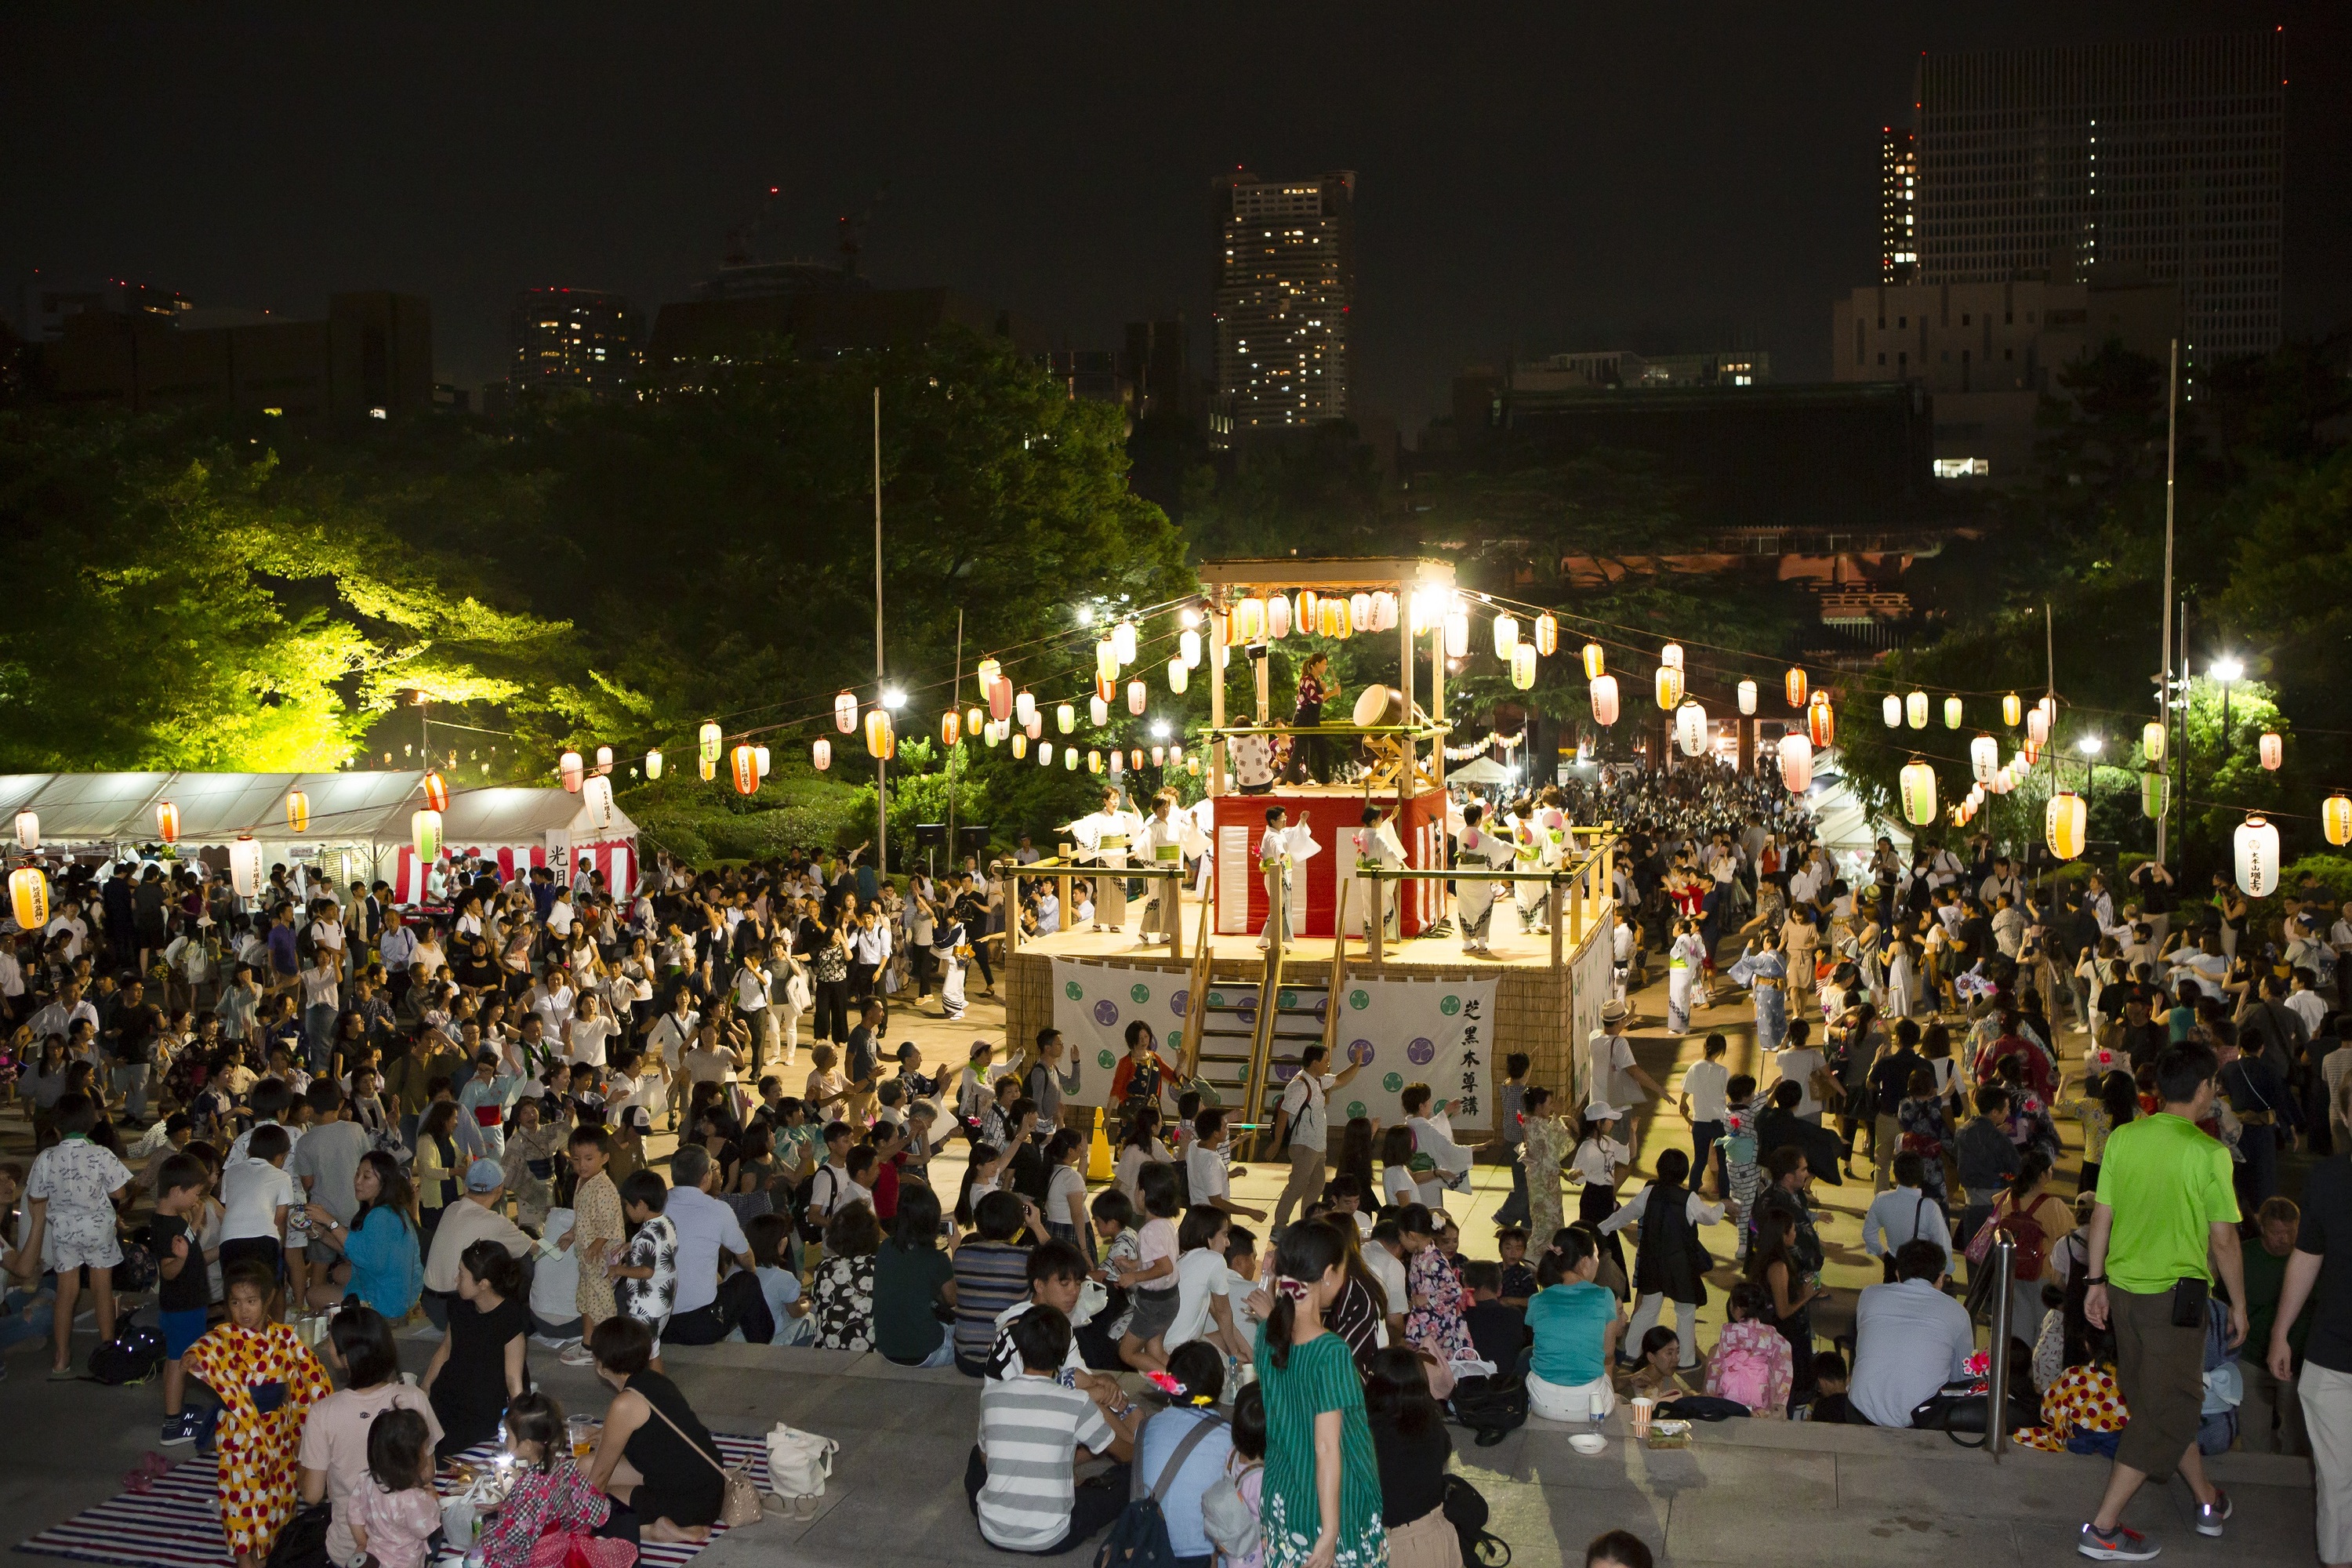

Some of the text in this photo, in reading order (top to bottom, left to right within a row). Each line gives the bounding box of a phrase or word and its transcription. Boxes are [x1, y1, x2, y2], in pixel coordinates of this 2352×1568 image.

[2250, 852, 2261, 891] 大本山増上寺
[1461, 1000, 1482, 1116] 芝黒本尊講
